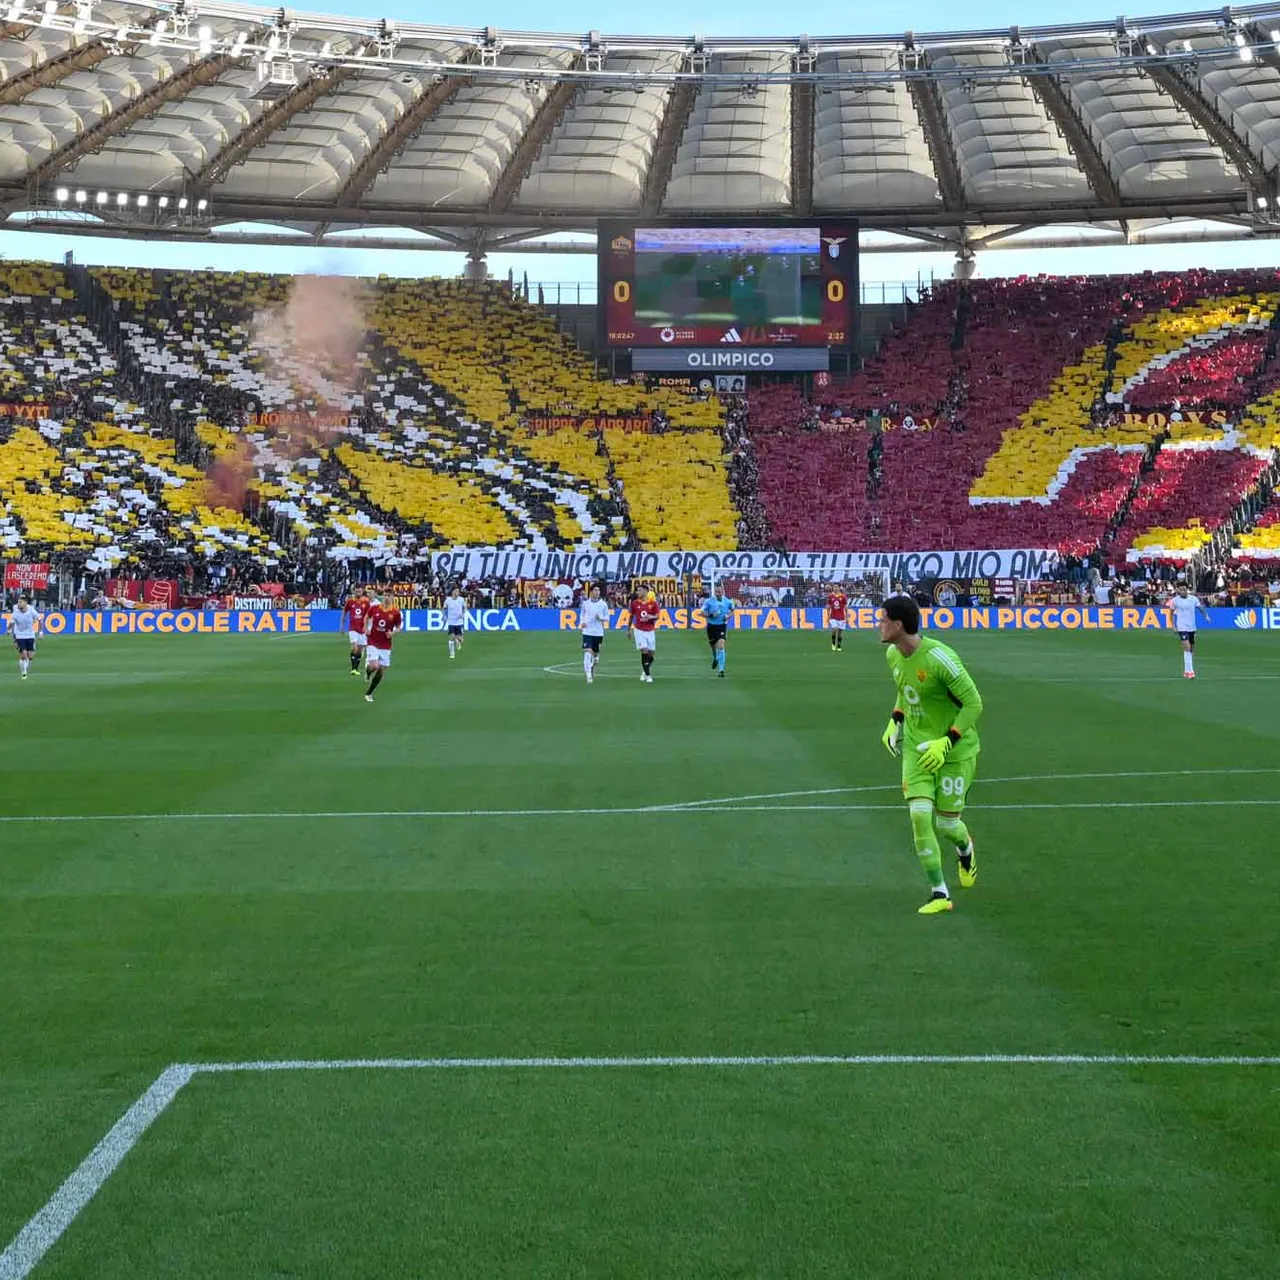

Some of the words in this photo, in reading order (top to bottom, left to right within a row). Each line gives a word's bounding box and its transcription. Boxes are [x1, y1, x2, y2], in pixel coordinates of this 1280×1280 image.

[614, 281, 630, 302] 0
[827, 280, 844, 301] 0
[687, 353, 774, 366] OLIMPICO
[16, 563, 33, 571] NON
[435, 553, 471, 579] SEI
[480, 552, 509, 580] TU
[806, 553, 840, 583] TU
[951, 551, 1002, 579] MIO
[234, 597, 272, 609] DISTINTI
[393, 595, 442, 609] BRIGTA
[74, 612, 103, 633] IN
[111, 611, 230, 632] PICCOLE
[238, 611, 311, 632] RATE
[791, 608, 814, 629] IL
[963, 608, 989, 629] IN
[993, 608, 1116, 629] PICCOLE
[1122, 608, 1175, 629] RAT
[941, 776, 965, 796] 99
